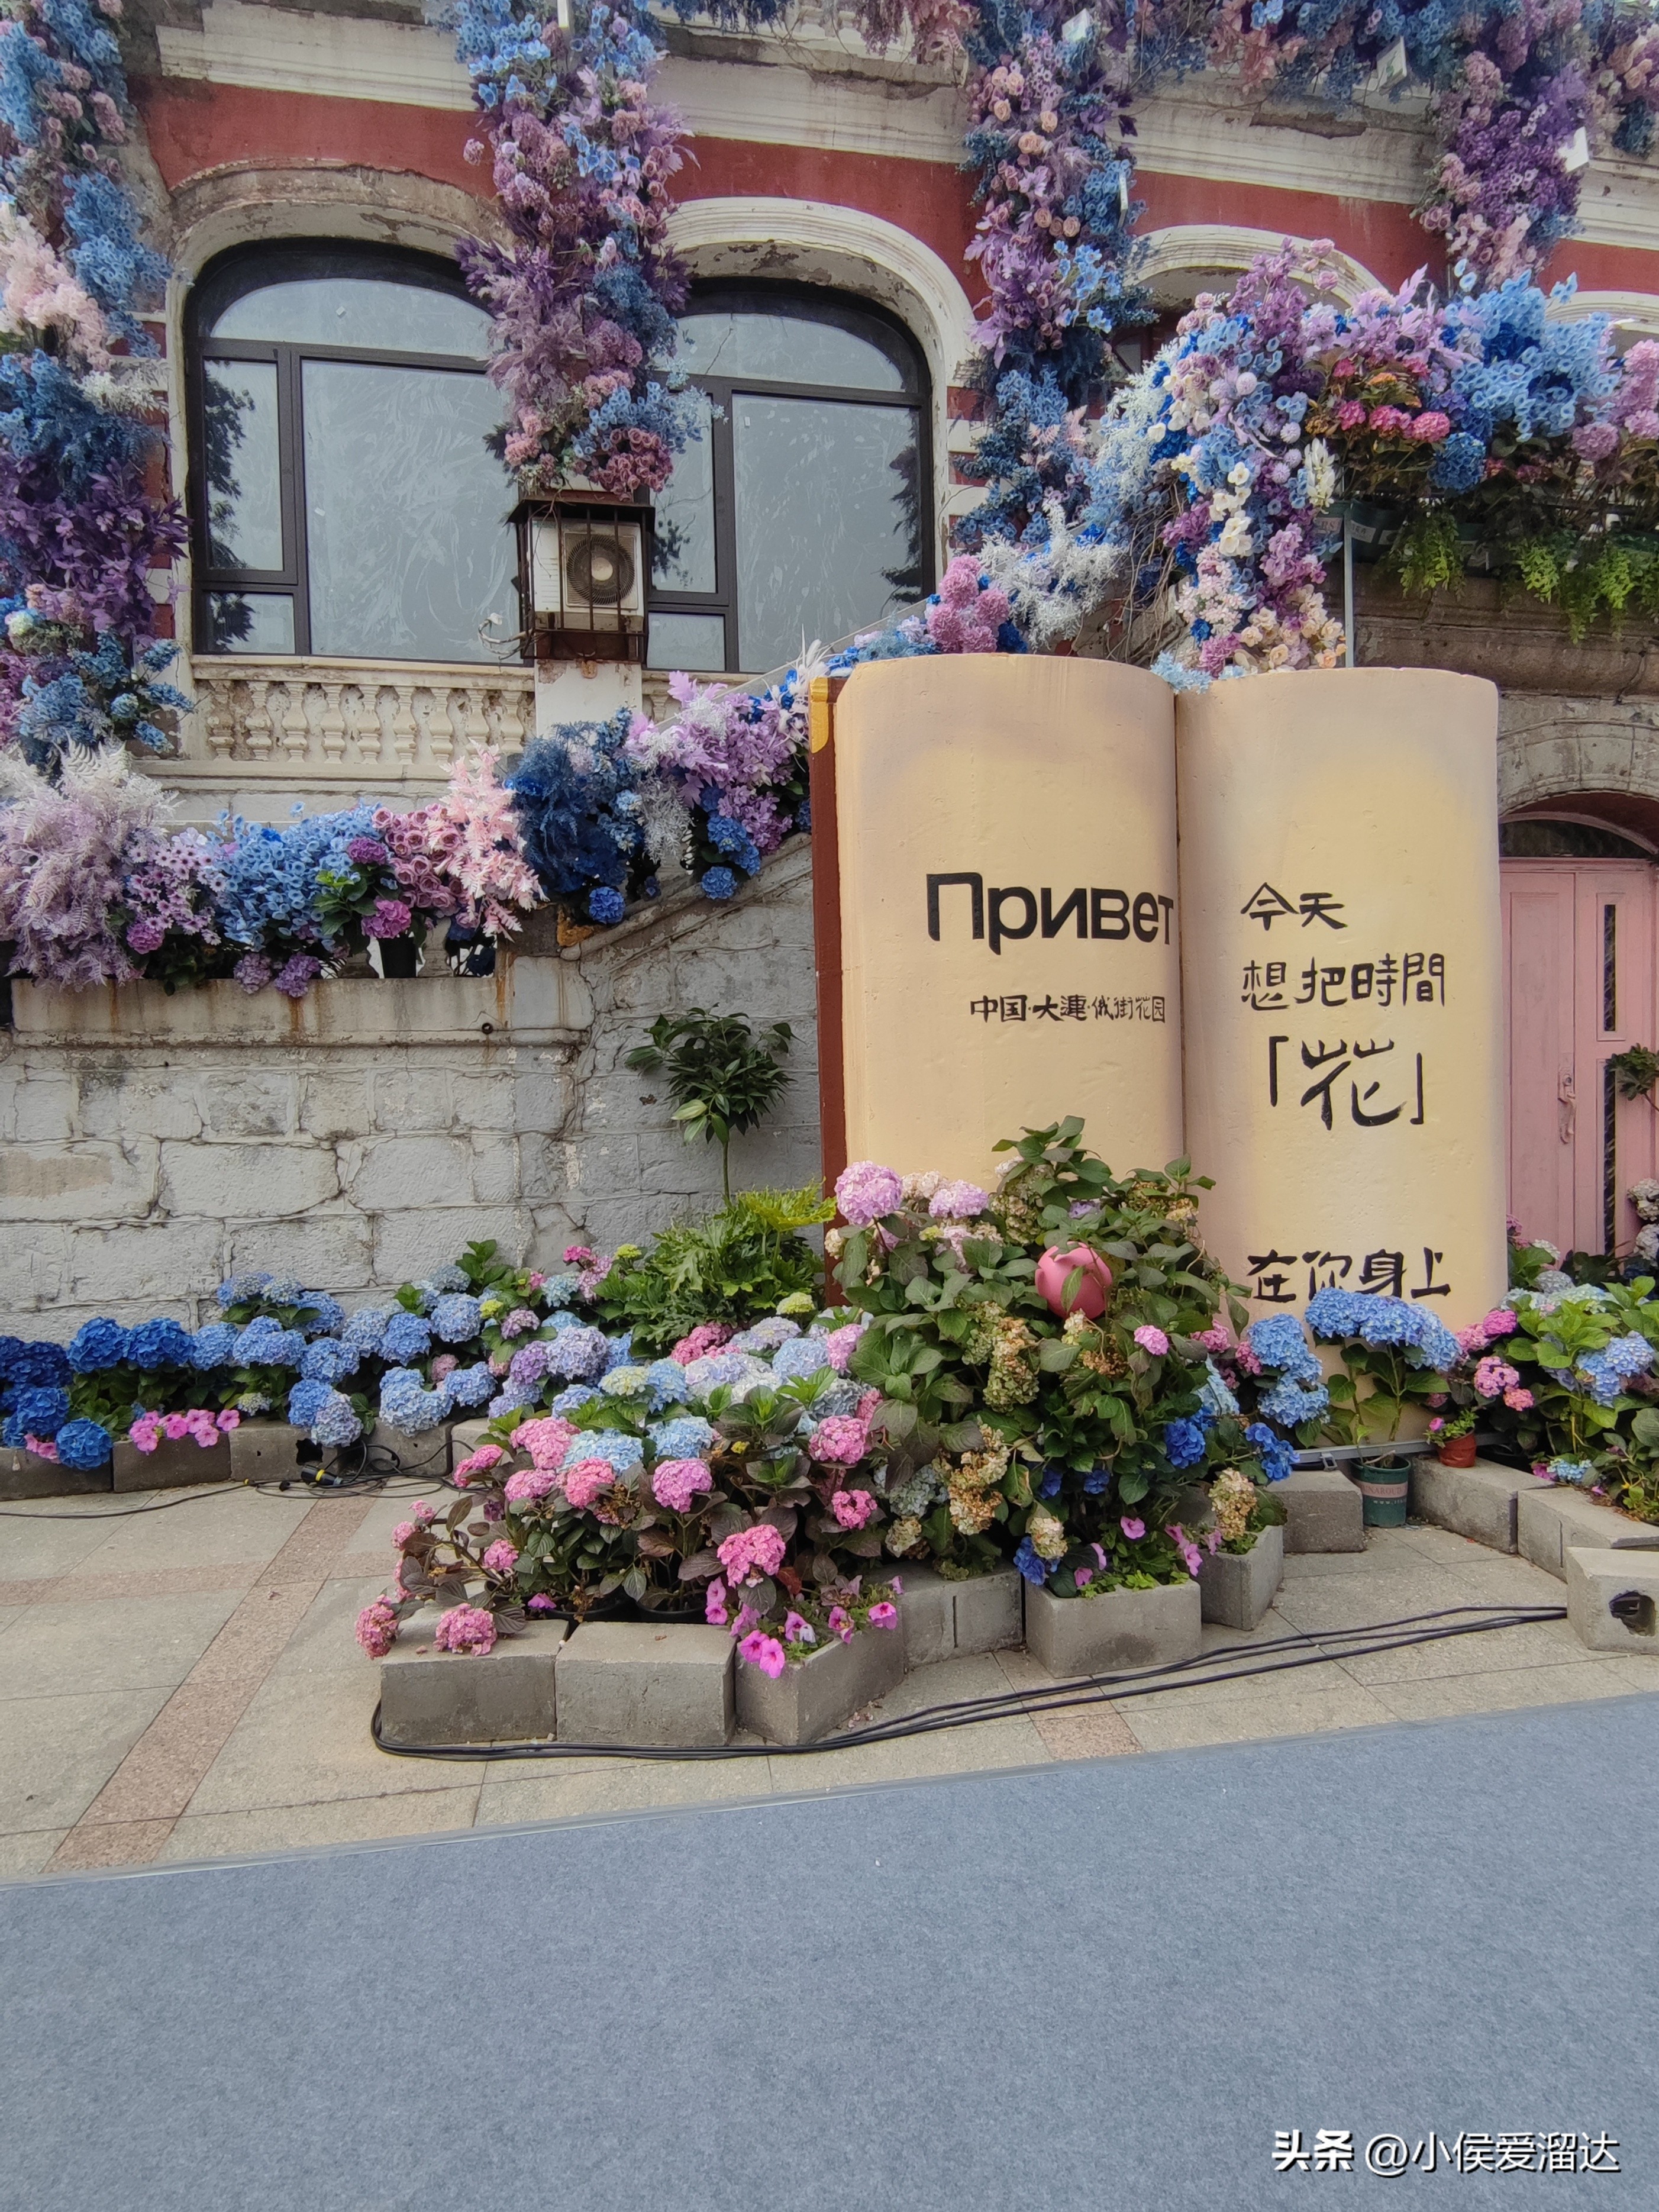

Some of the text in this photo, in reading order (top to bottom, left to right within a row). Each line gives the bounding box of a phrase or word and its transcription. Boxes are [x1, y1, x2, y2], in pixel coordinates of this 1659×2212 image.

[926, 872, 1174, 956] Привет
[1240, 882, 1348, 931] 今天
[1241, 952, 1445, 1011] 想把時間
[1269, 1036, 1425, 1131] 「花」
[1246, 1246, 1451, 1302] 在你身上
